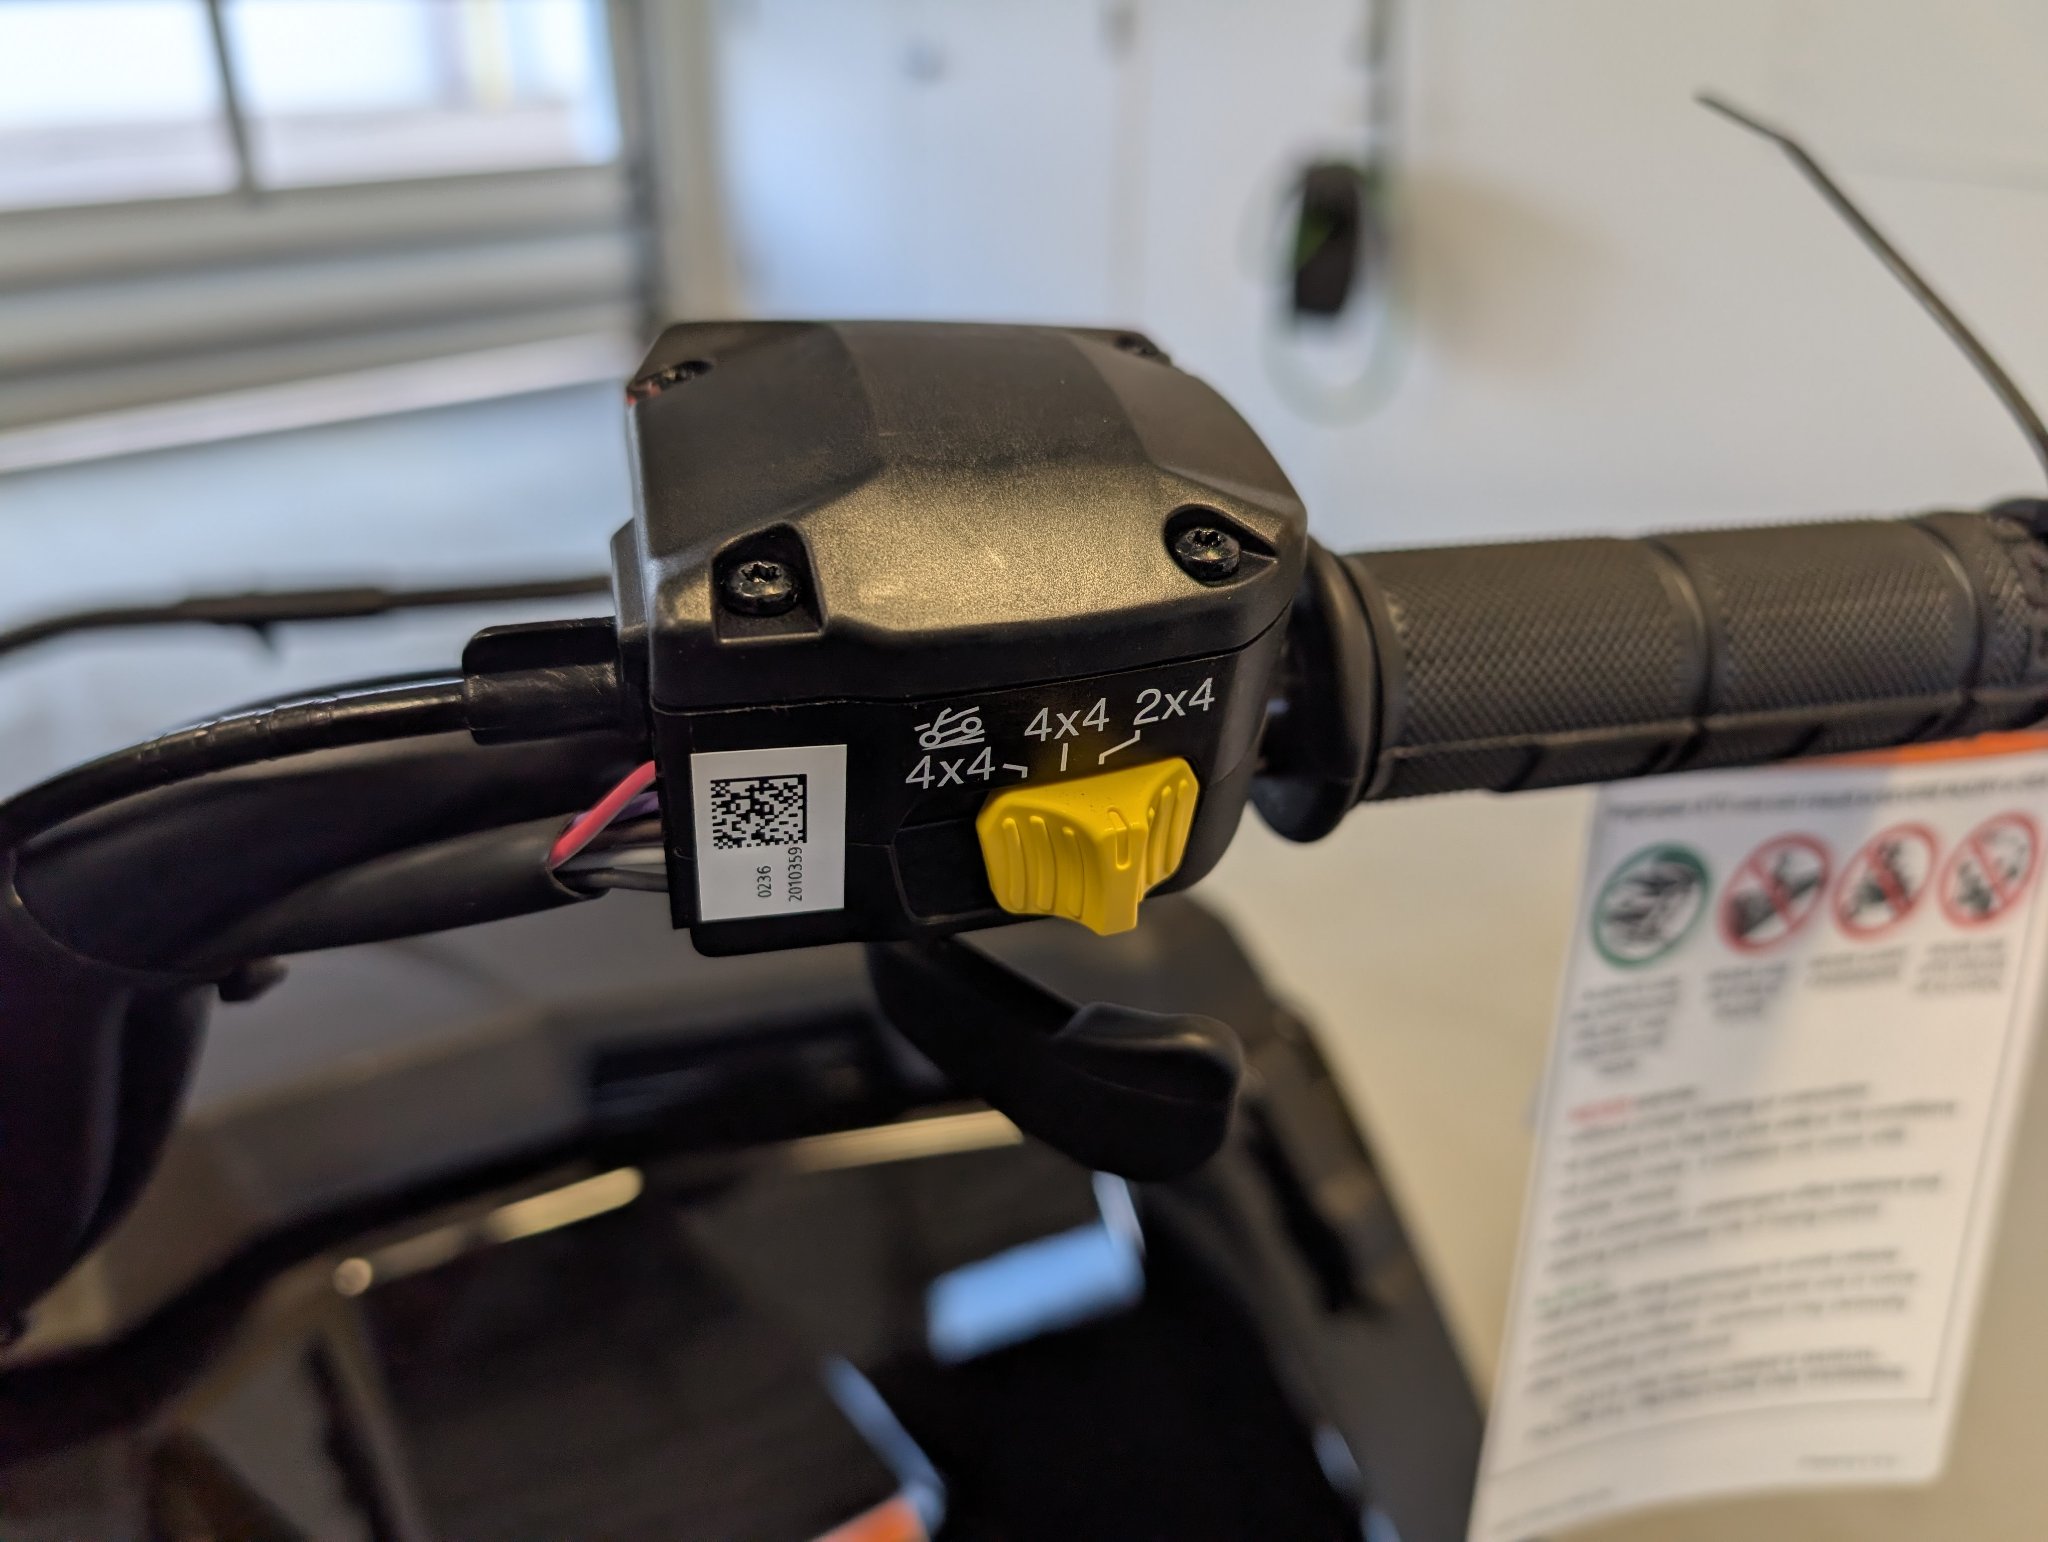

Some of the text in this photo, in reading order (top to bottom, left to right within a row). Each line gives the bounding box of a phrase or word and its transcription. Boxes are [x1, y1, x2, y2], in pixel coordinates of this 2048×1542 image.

[1024, 697, 1109, 742] 4x4
[1133, 677, 1215, 726] 2x4
[905, 746, 996, 790] 4x4
[757, 865, 772, 898] 0236
[787, 846, 803, 902] 2010359
